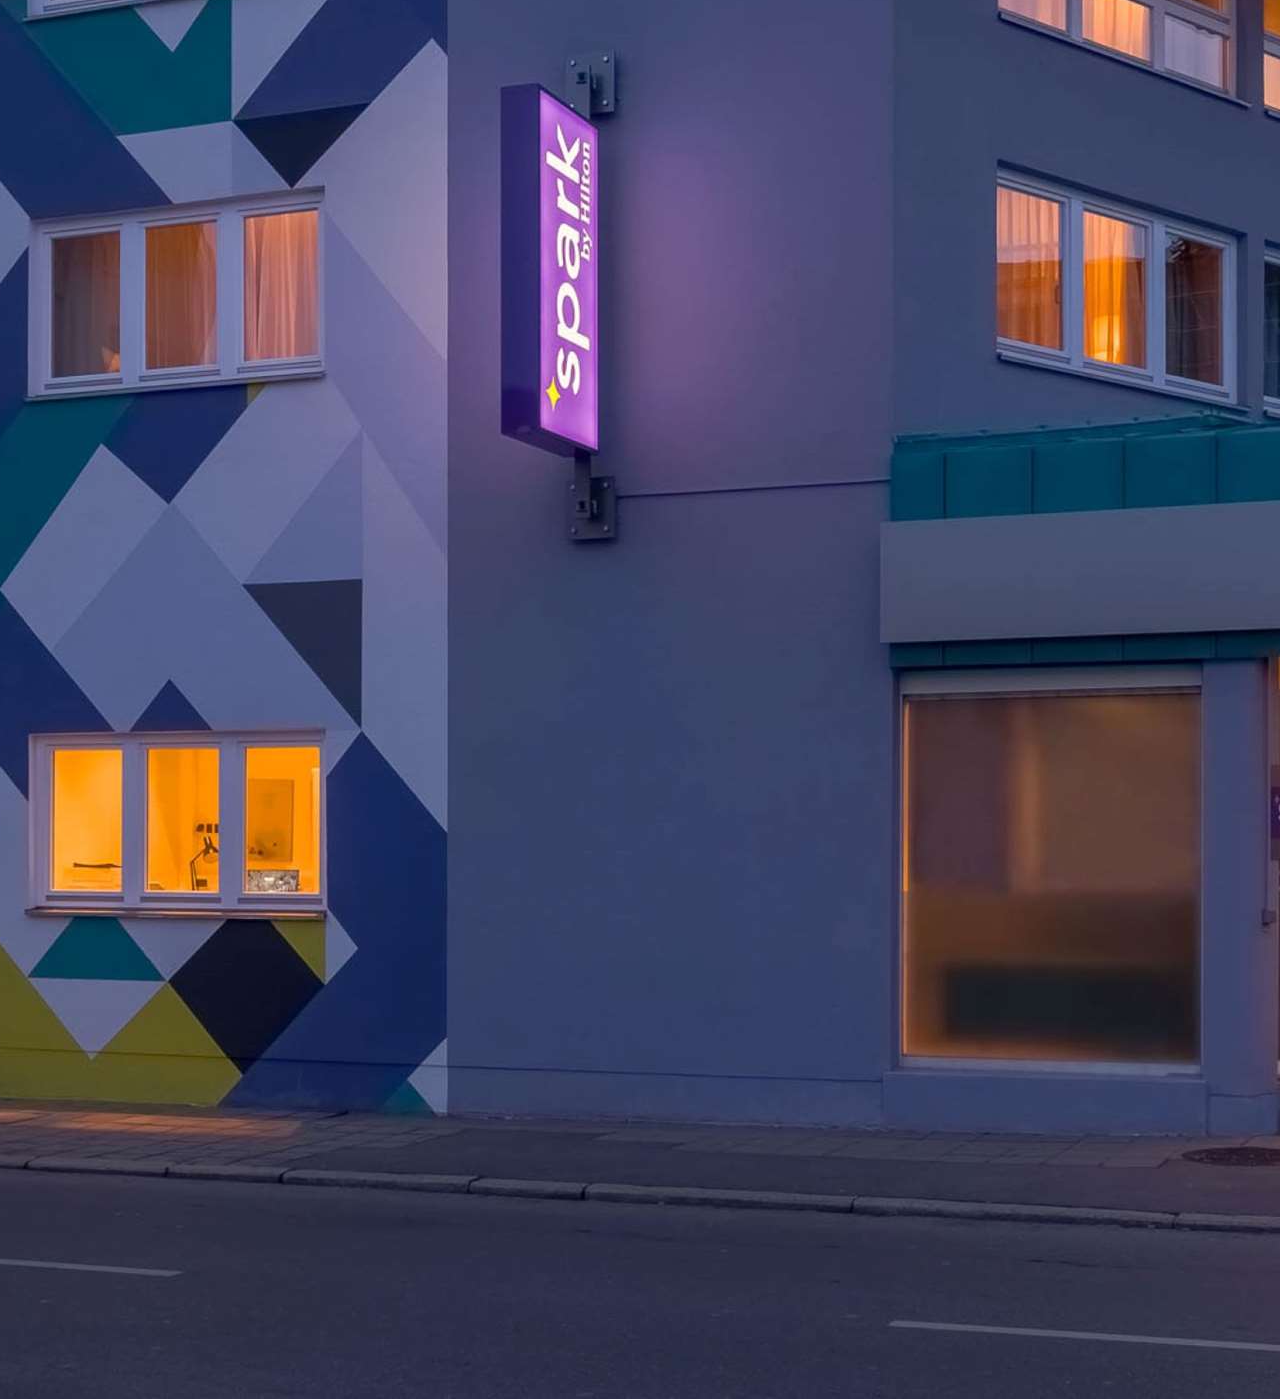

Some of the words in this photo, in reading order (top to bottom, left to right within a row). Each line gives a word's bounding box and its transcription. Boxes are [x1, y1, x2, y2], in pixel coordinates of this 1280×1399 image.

[580, 142, 591, 225] Hilton
[545, 123, 590, 395] spark
[580, 228, 593, 262] by
